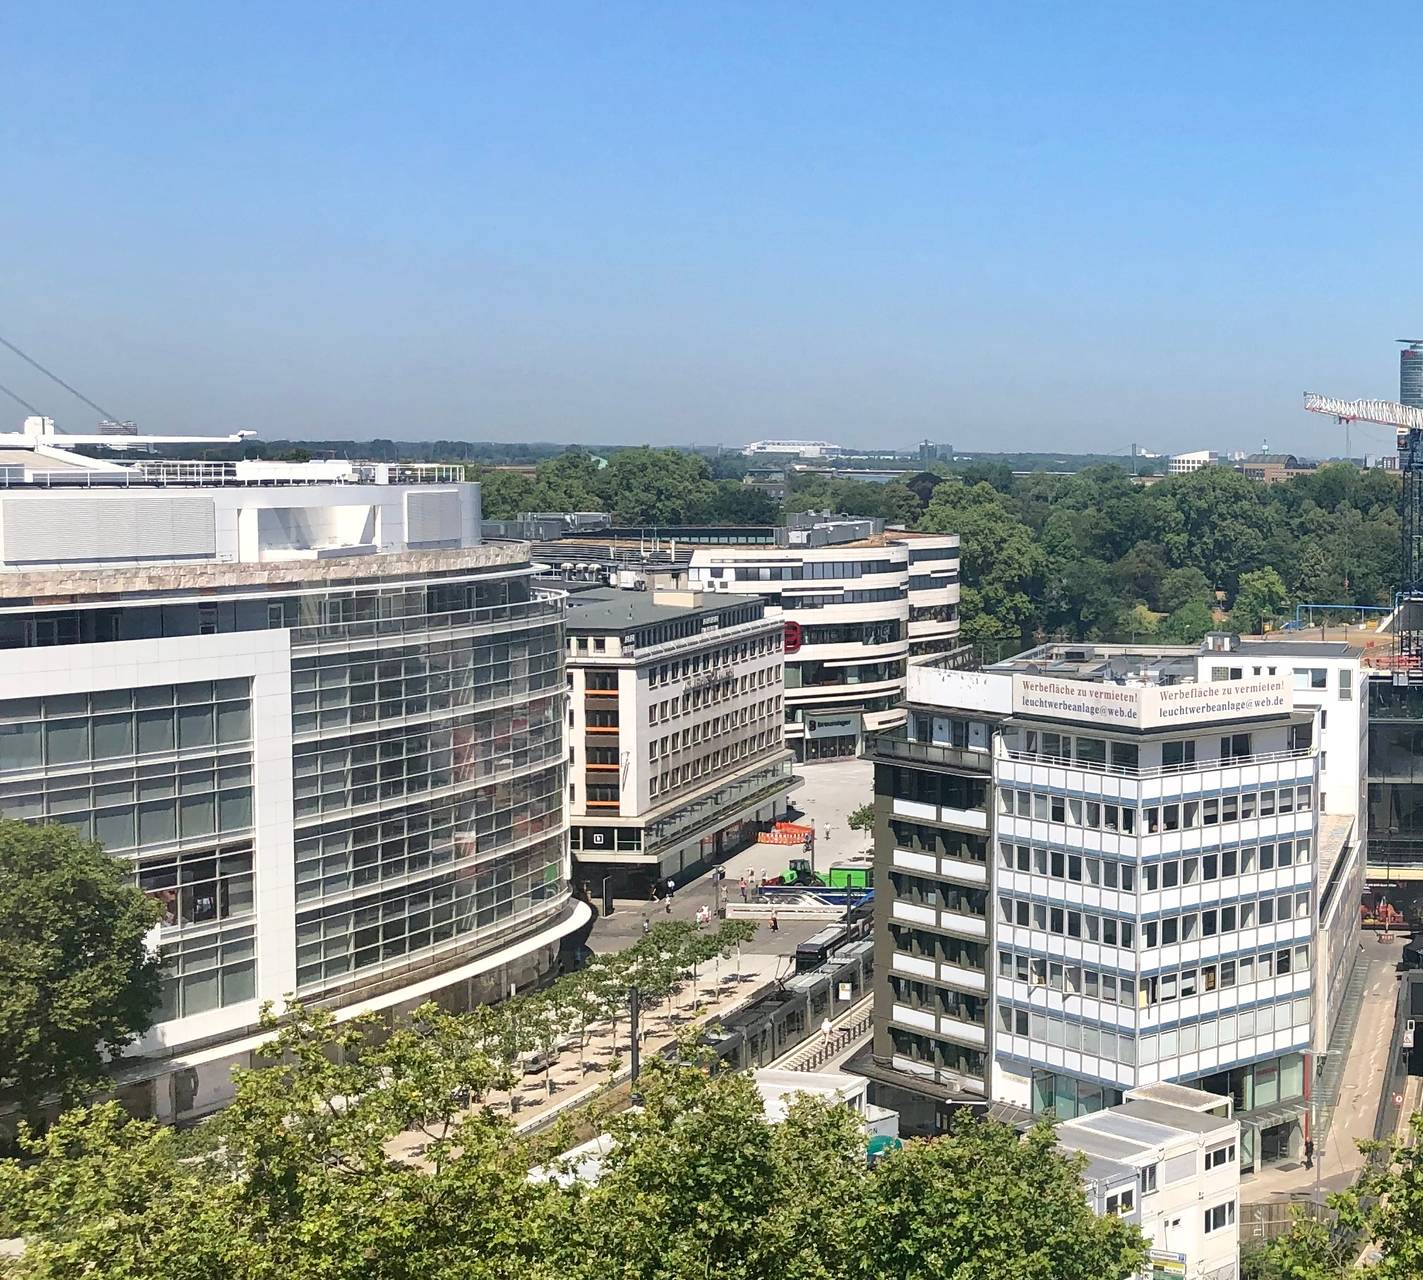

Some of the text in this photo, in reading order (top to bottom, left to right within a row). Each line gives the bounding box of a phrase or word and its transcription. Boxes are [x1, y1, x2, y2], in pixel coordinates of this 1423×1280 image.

[1022, 680, 1138, 703] Werbefläche zu vermieten!
[1160, 680, 1285, 701] Werbefläche zu vermieten!
[1022, 695, 1138, 719] leuchtwerbeanlage@web.de
[1159, 696, 1284, 718] leuchtwerbeanlage@web.de
